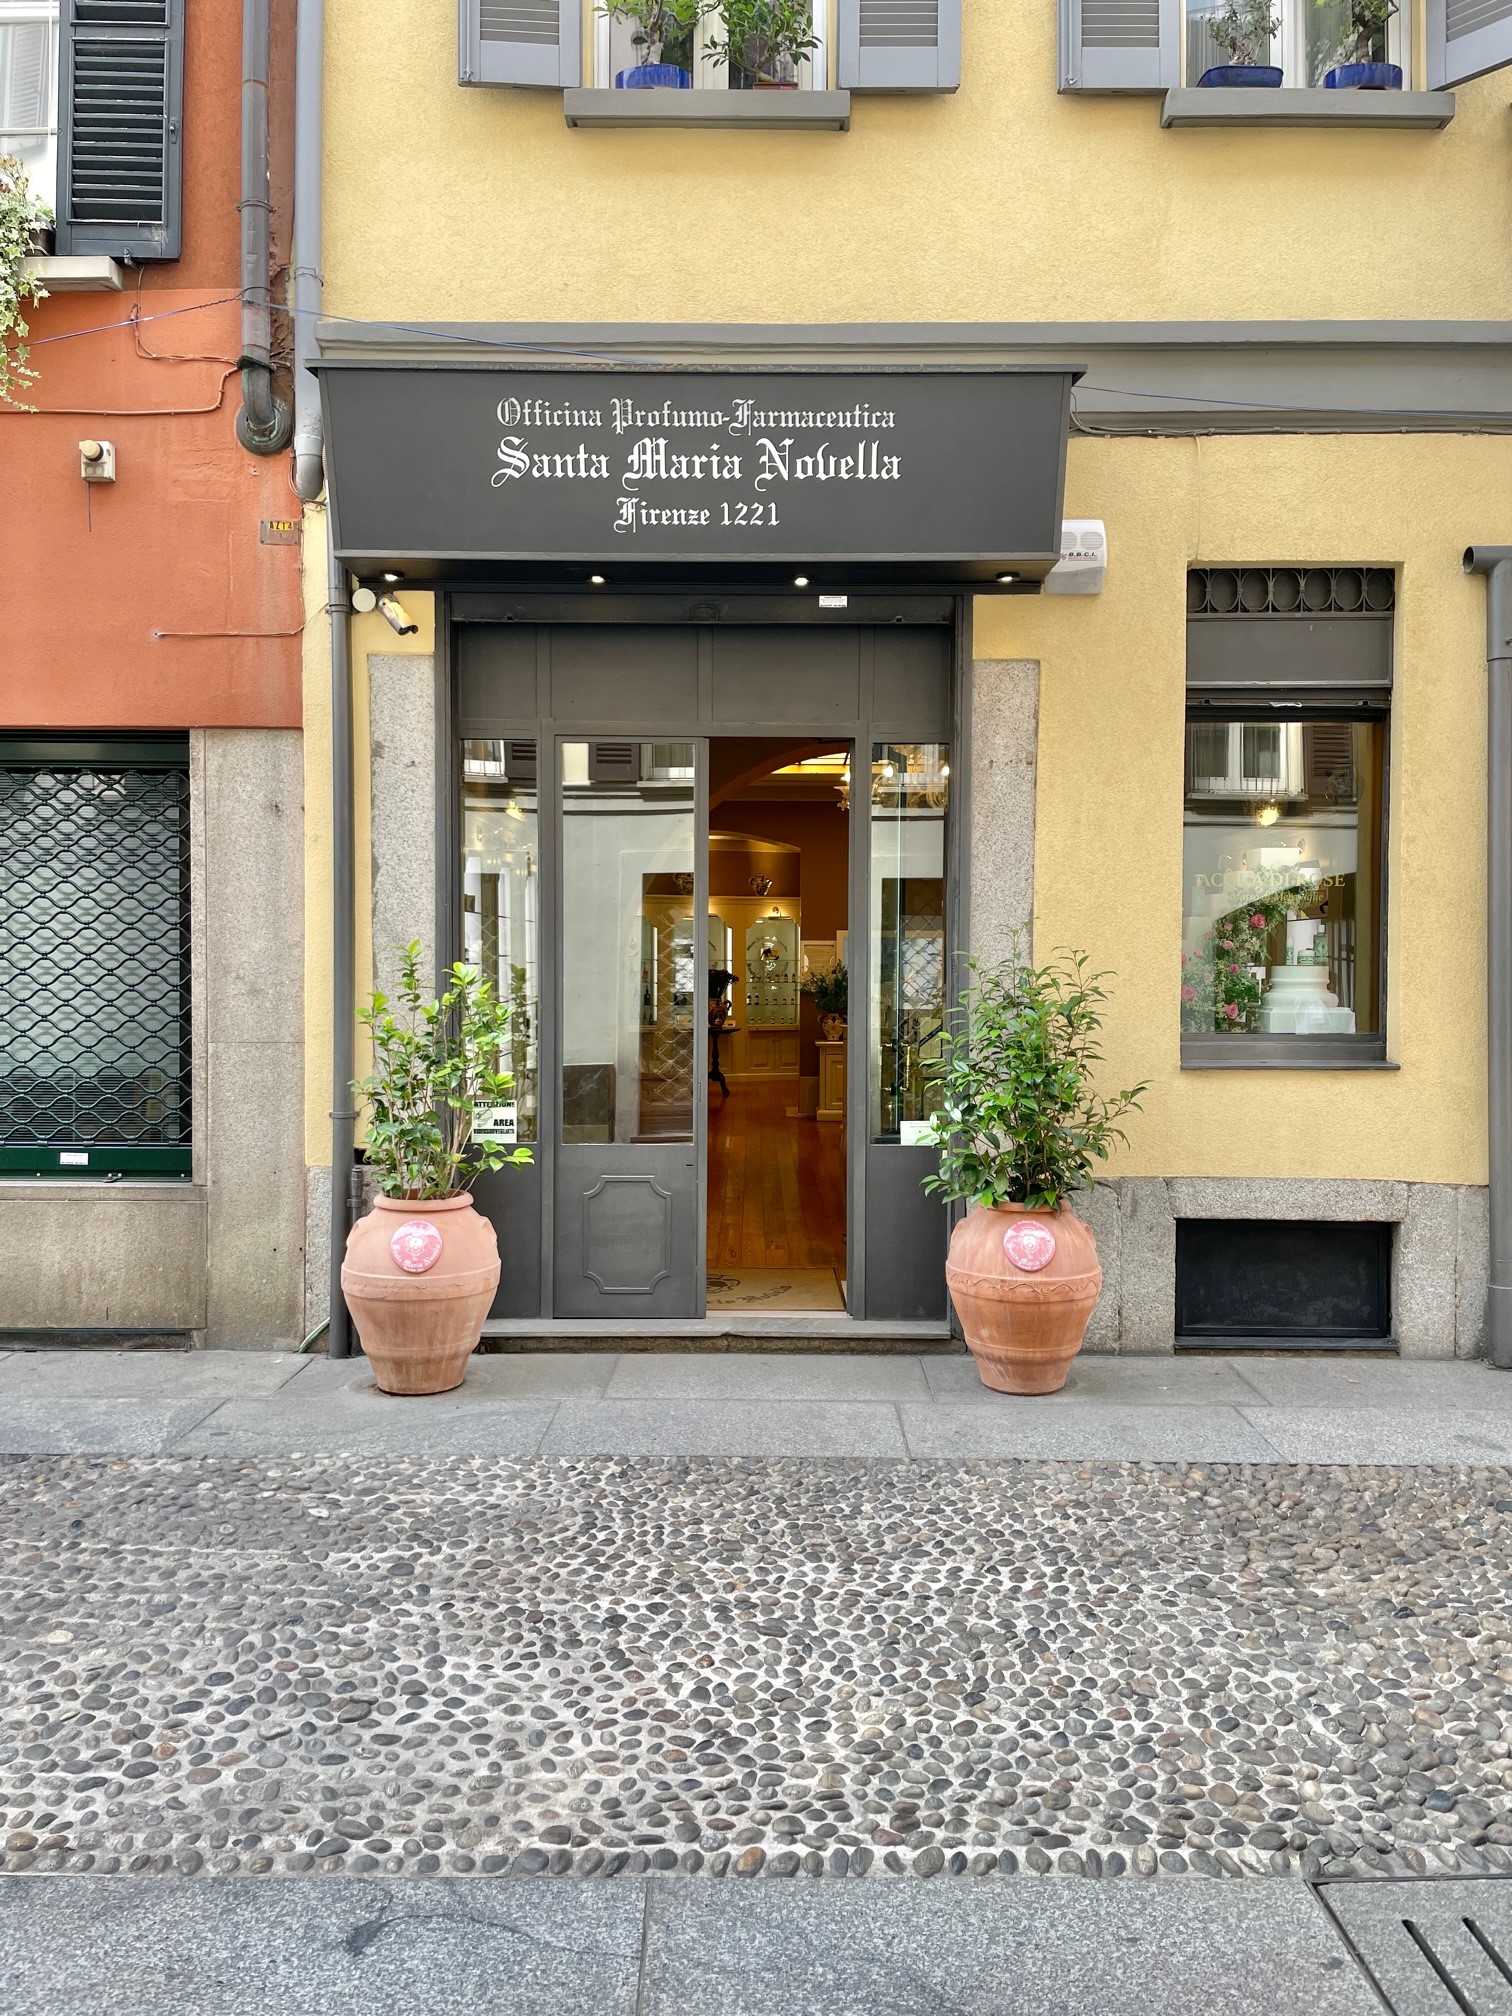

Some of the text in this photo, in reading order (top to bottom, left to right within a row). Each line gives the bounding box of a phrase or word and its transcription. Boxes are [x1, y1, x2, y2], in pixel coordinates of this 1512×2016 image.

[497, 398, 895, 436] Officina Profumo-Farmaceutica
[491, 436, 901, 491] Santa Maria Novella
[614, 497, 780, 533] Firenze 1221
[1296, 873, 1346, 887] ROSE
